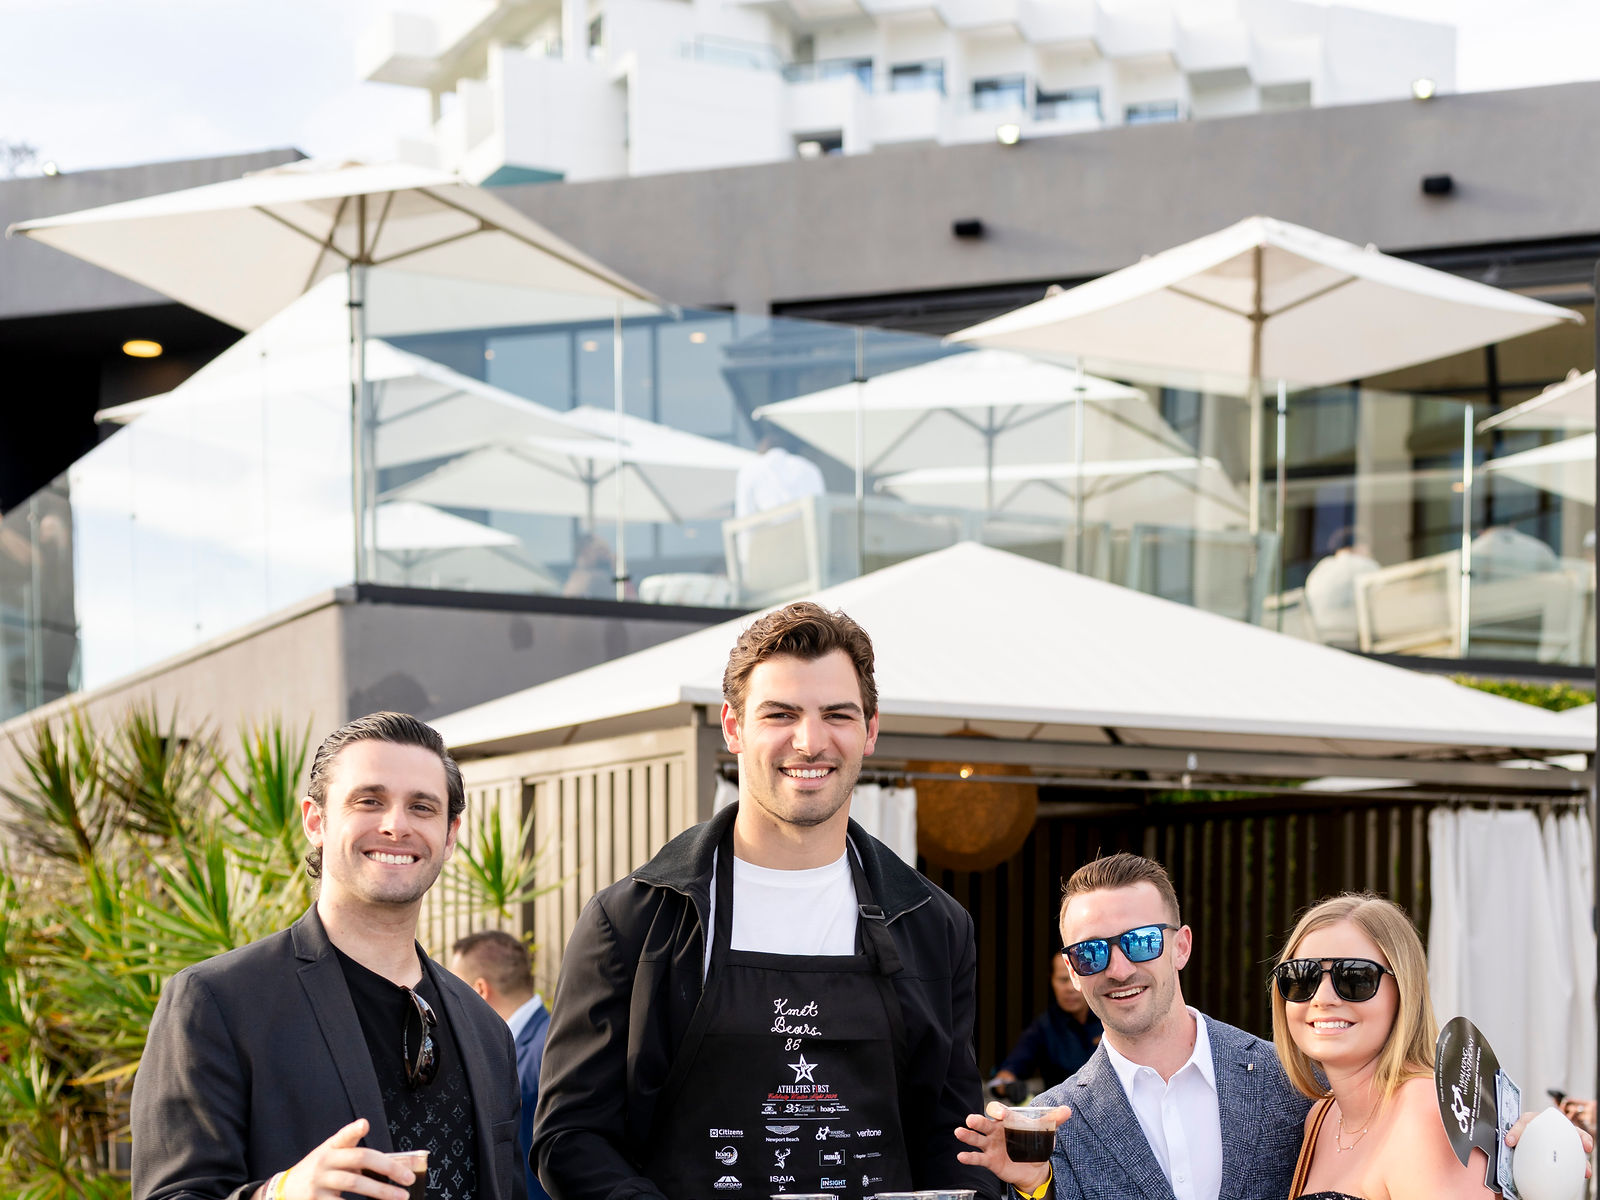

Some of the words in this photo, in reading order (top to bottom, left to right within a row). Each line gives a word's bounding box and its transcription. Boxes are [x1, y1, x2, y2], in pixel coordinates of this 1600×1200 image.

[774, 998, 818, 1016] Kmet
[770, 1016, 822, 1036] Bears
[777, 1084, 810, 1094] ATHLETES
[783, 1103, 801, 1113] 25
[856, 1129, 882, 1137] veritone
